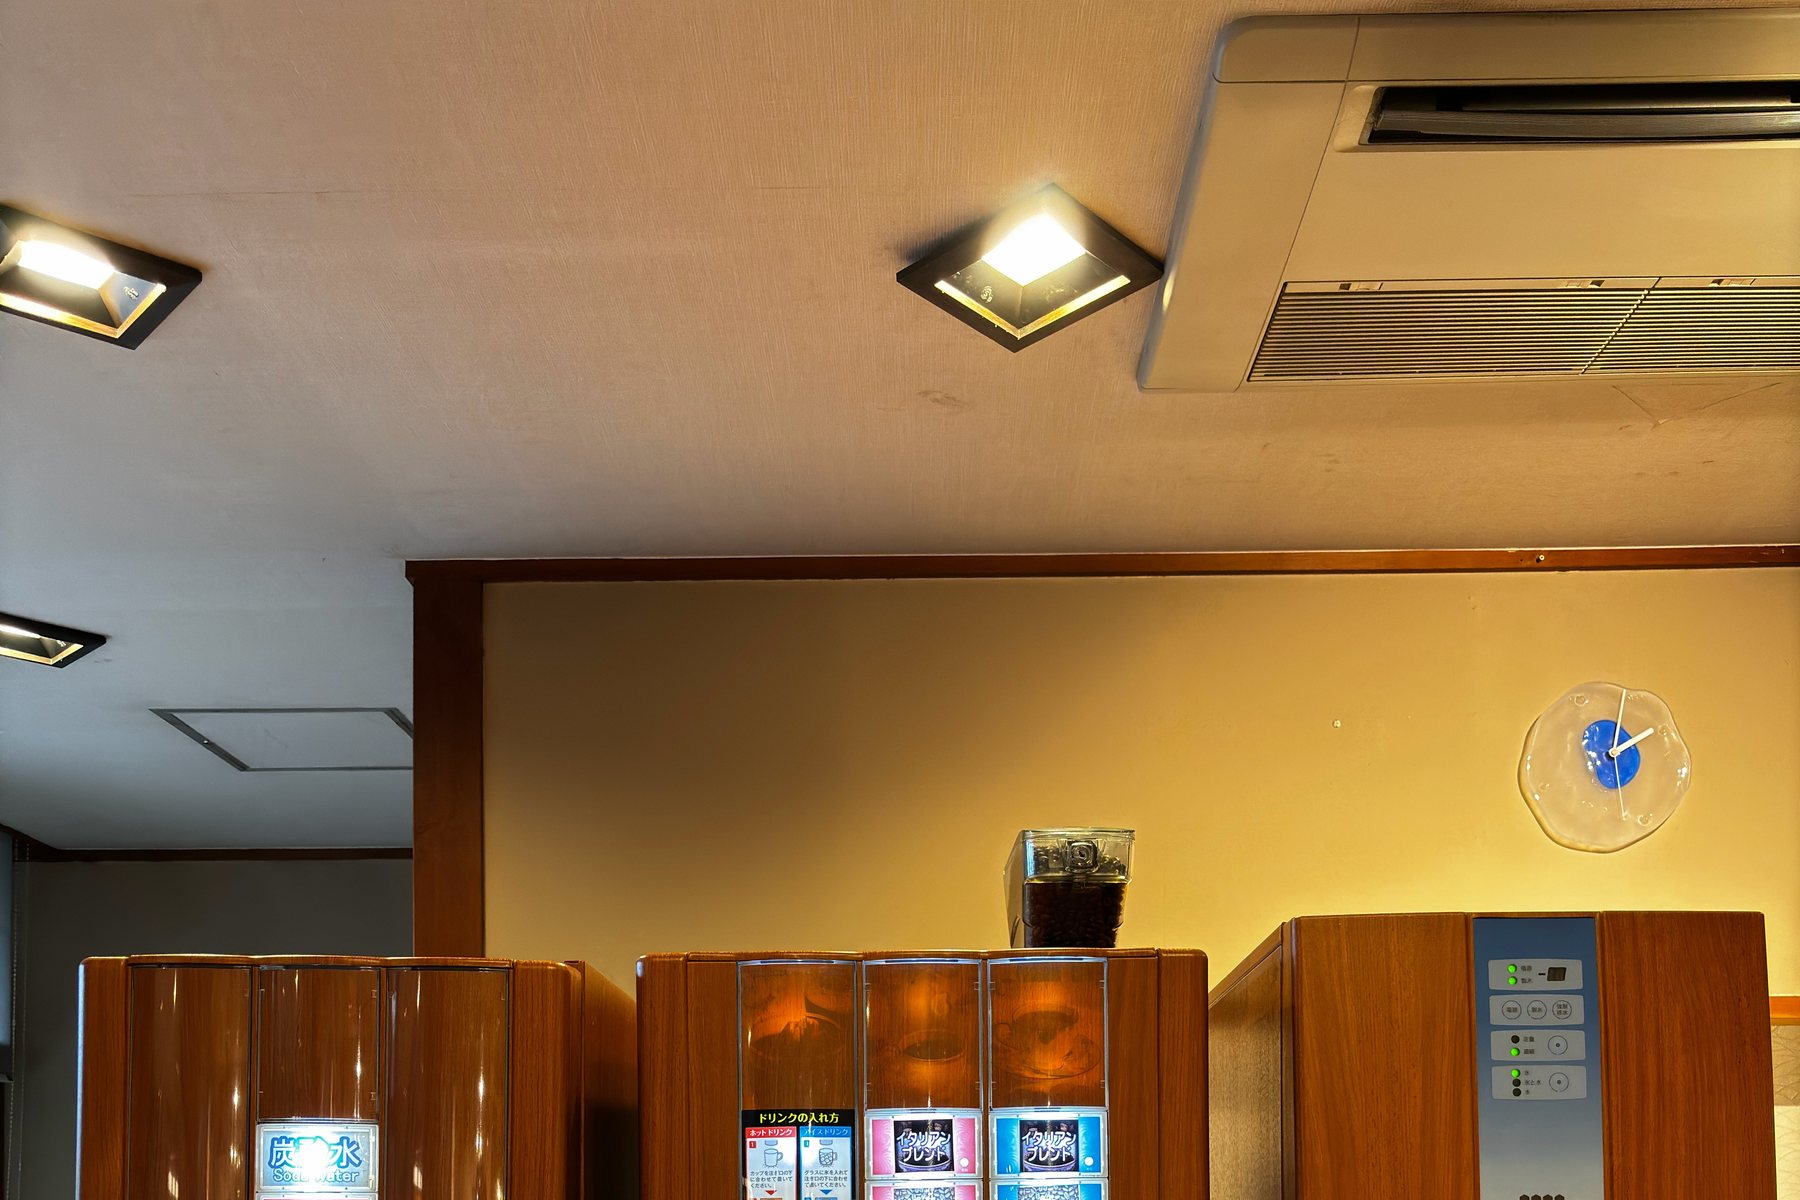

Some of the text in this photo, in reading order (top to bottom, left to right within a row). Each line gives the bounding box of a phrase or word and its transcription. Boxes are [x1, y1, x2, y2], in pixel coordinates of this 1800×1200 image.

[759, 1113, 839, 1124] ドリンクの入れ方
[896, 1131, 951, 1146] イタリアン
[1022, 1131, 1077, 1146] イタリアン
[268, 1135, 362, 1169] 炭水
[1027, 1146, 1072, 1162] ブレンド
